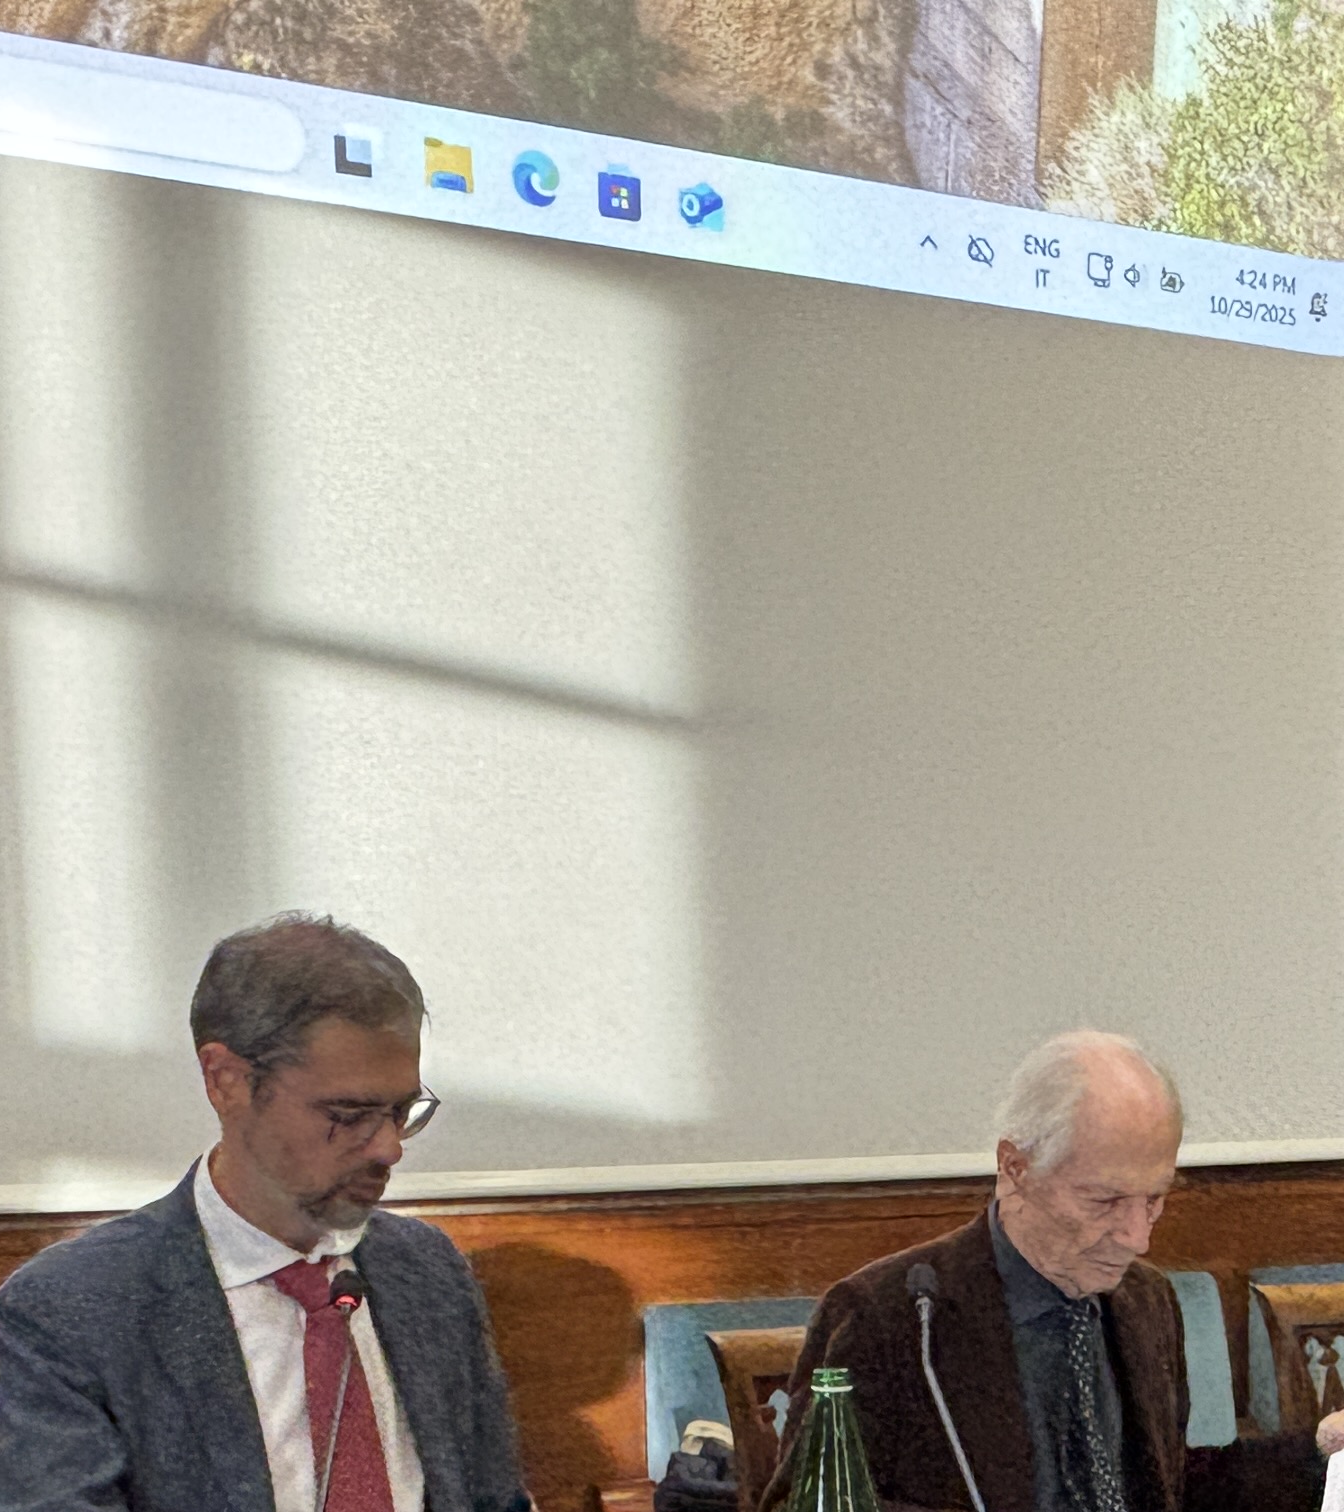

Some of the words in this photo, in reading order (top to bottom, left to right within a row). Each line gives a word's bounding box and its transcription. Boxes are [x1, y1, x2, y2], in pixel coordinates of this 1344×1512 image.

[1024, 234, 1060, 259] ENG
[1036, 268, 1050, 289] IT
[1273, 273, 1296, 296] PM
[1210, 295, 1297, 326] 10/29/2025
